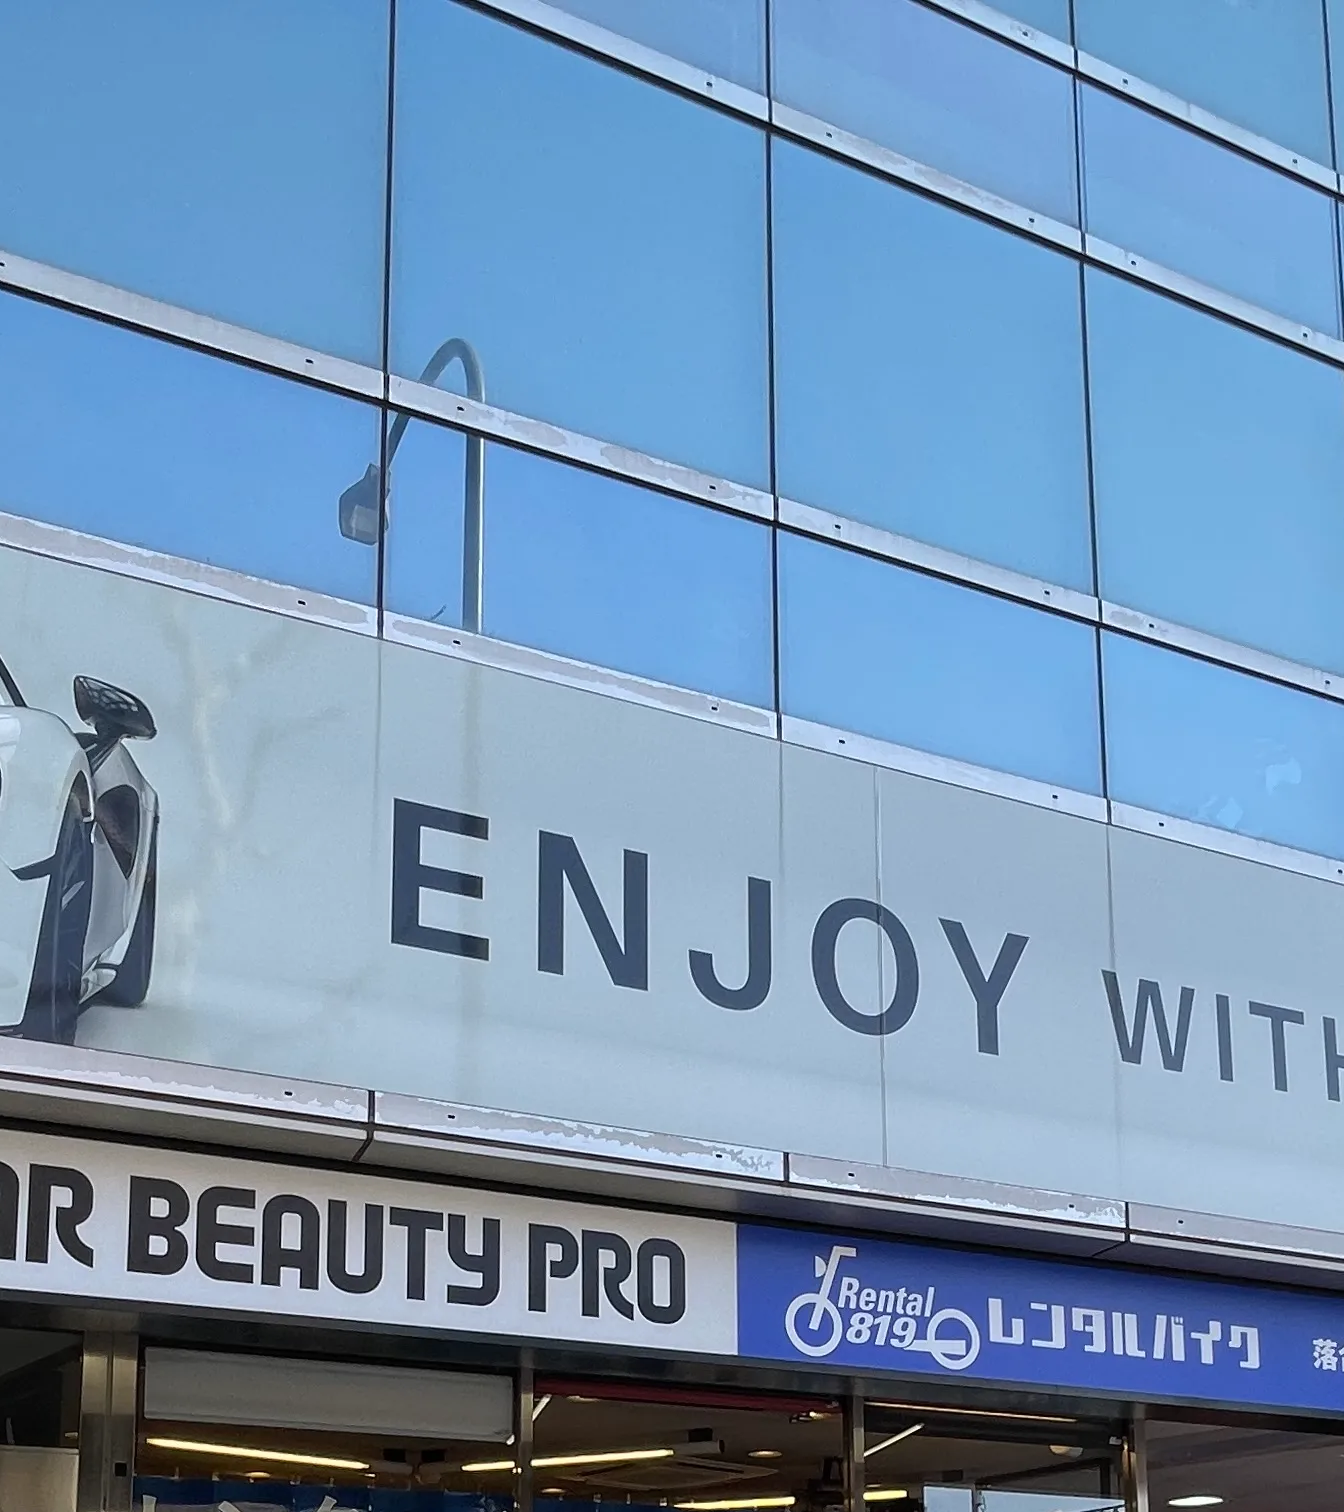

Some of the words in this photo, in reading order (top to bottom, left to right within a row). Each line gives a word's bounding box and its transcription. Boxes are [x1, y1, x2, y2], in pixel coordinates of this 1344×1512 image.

[391, 797, 1030, 1056] ENJOY
[126, 1175, 501, 1308] BEAUTY
[527, 1222, 687, 1325] PRO
[838, 1276, 936, 1318] Rental
[846, 1313, 918, 1349] 819
[987, 1297, 1260, 1369] レンタルバイク
